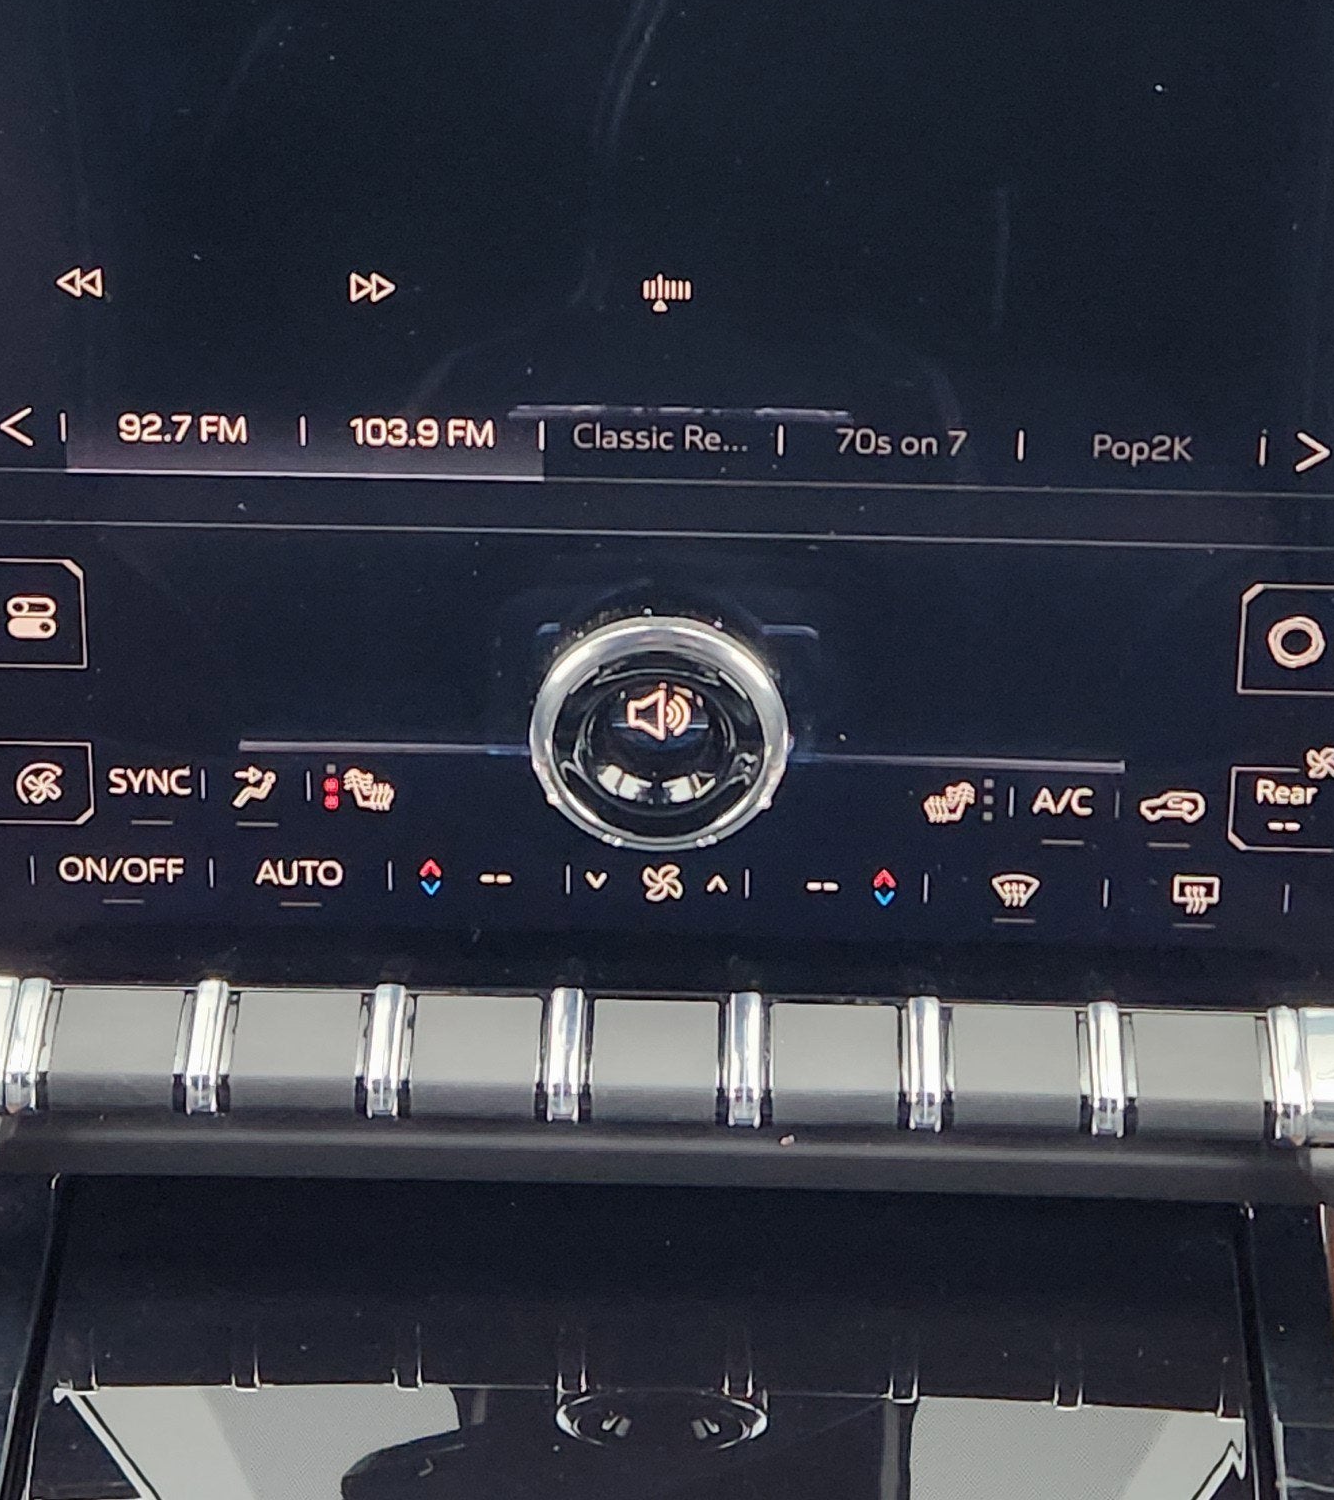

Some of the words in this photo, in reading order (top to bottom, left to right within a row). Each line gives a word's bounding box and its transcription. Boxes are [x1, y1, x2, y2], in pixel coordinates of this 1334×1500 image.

[118, 412, 193, 444] 92.7
[200, 414, 249, 444] FM
[349, 416, 440, 448] 103.9
[447, 418, 495, 449] FM
[573, 421, 674, 451] Classic
[684, 425, 749, 452] Re...
[836, 427, 893, 456] 70s
[900, 436, 939, 457] on
[947, 430, 968, 457] 7
[1093, 435, 1193, 466] Pop2K
[107, 765, 192, 797] SYNC
[1255, 777, 1319, 806] Rear
[1032, 787, 1094, 816] A/C
[58, 855, 185, 885] ON/OFF
[255, 859, 344, 887] AUTO
